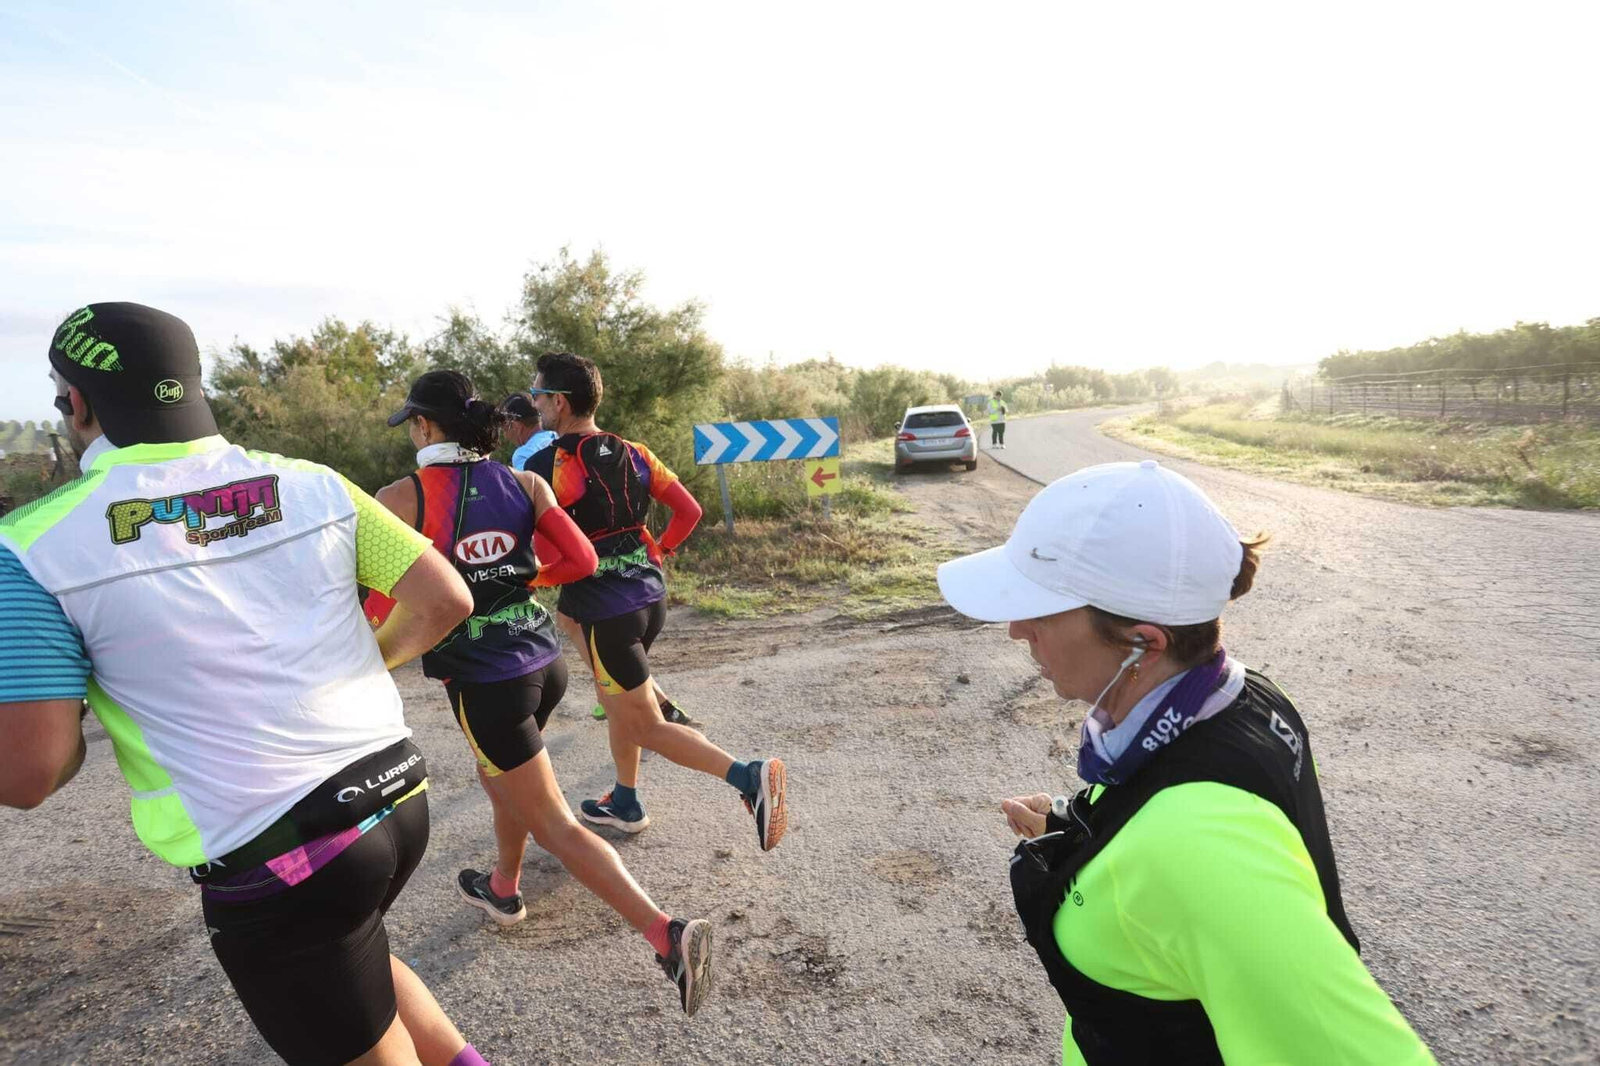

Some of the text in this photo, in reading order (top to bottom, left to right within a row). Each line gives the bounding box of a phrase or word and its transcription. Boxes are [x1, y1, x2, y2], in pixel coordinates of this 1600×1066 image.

[461, 536, 508, 561] KIA
[1141, 706, 1183, 751] 2018
[365, 754, 422, 789] LURBEL
